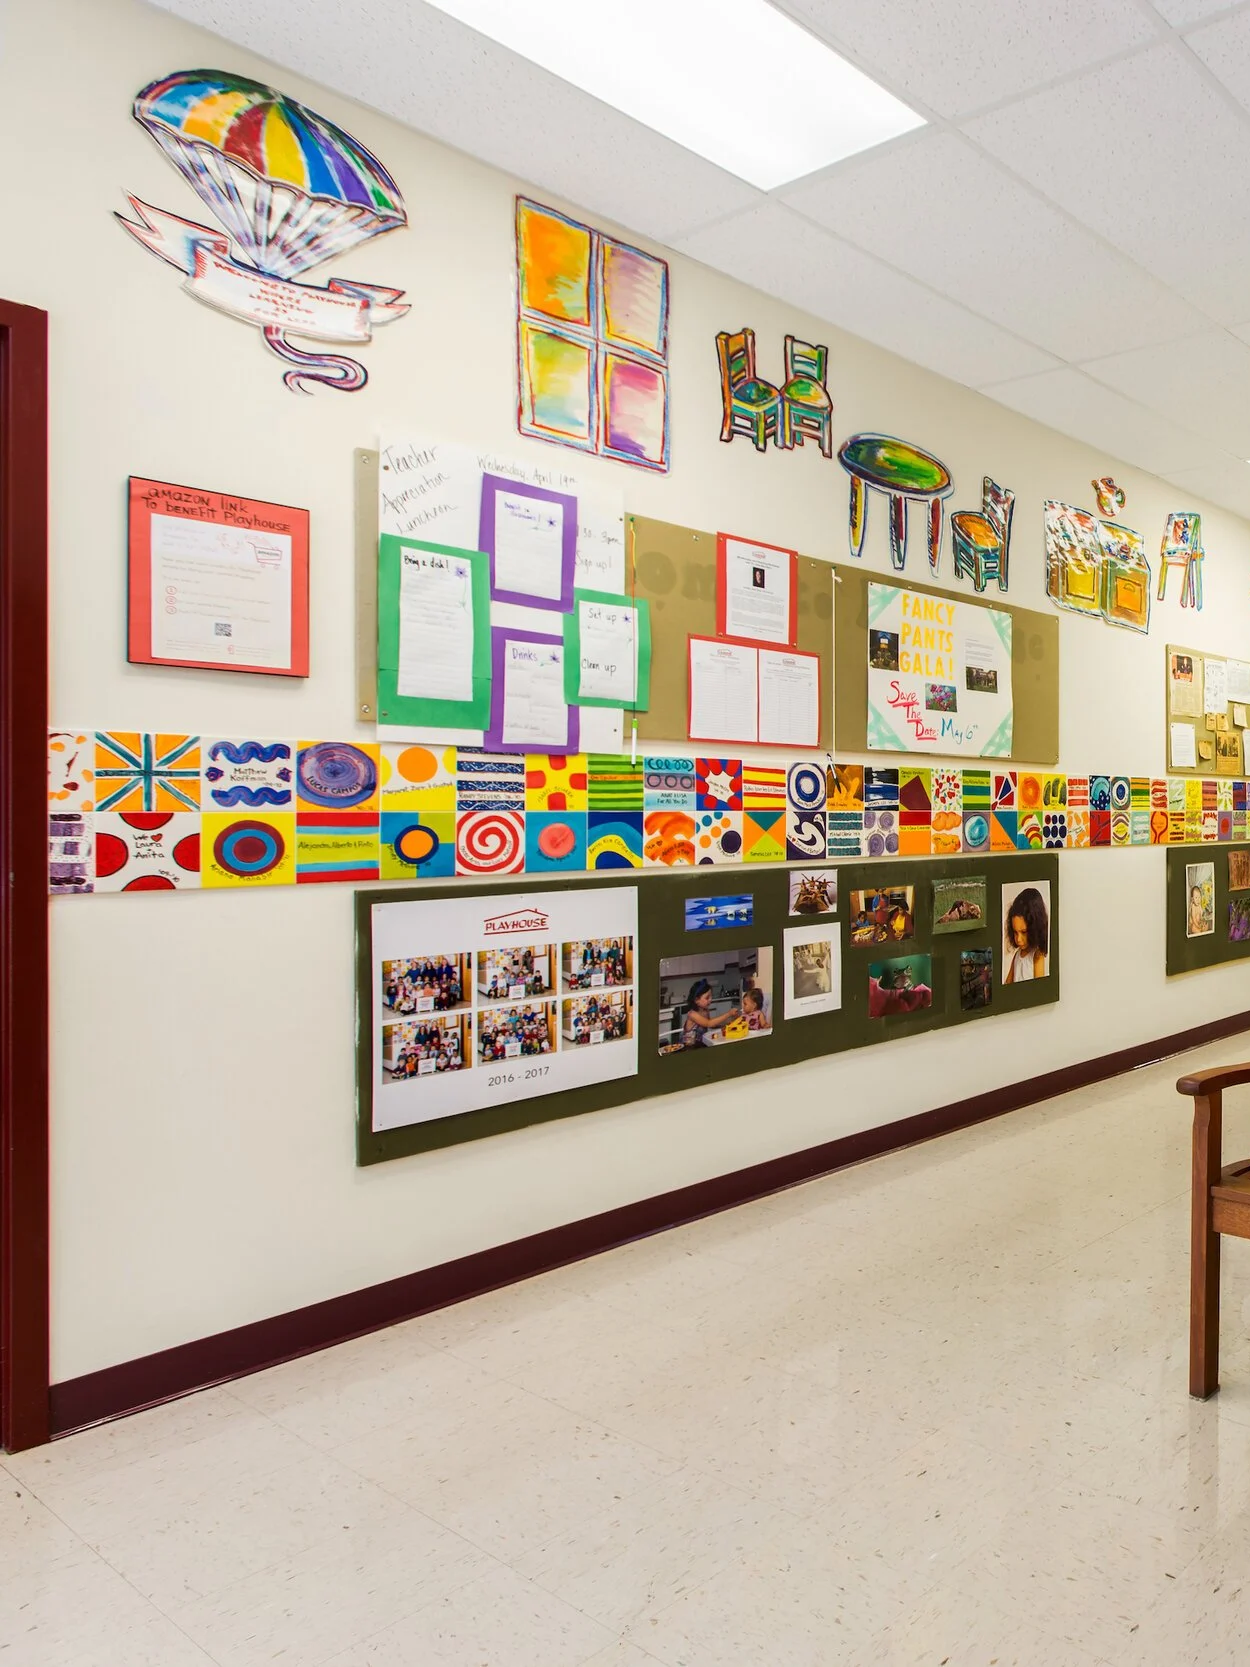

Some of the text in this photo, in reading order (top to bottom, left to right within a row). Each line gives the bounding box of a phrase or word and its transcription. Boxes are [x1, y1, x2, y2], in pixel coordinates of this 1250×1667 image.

[382, 443, 438, 475] Teacher
[396, 503, 459, 535] Luncheon
[902, 594, 955, 627] FANCY
[901, 621, 954, 653] PANTS
[512, 647, 539, 662] Drinks
[581, 658, 617, 677] Clean up
[900, 651, 954, 680] GALA!
[886, 680, 918, 705] Save
[906, 703, 922, 719] The
[941, 718, 963, 745] May
[306, 775, 329, 795] LUCAS
[133, 850, 165, 860] Anita
[135, 841, 163, 849] Laura
[485, 917, 548, 932] PLAYHOUSE
[488, 1073, 514, 1087] 2016
[525, 1066, 550, 1081] 2017
